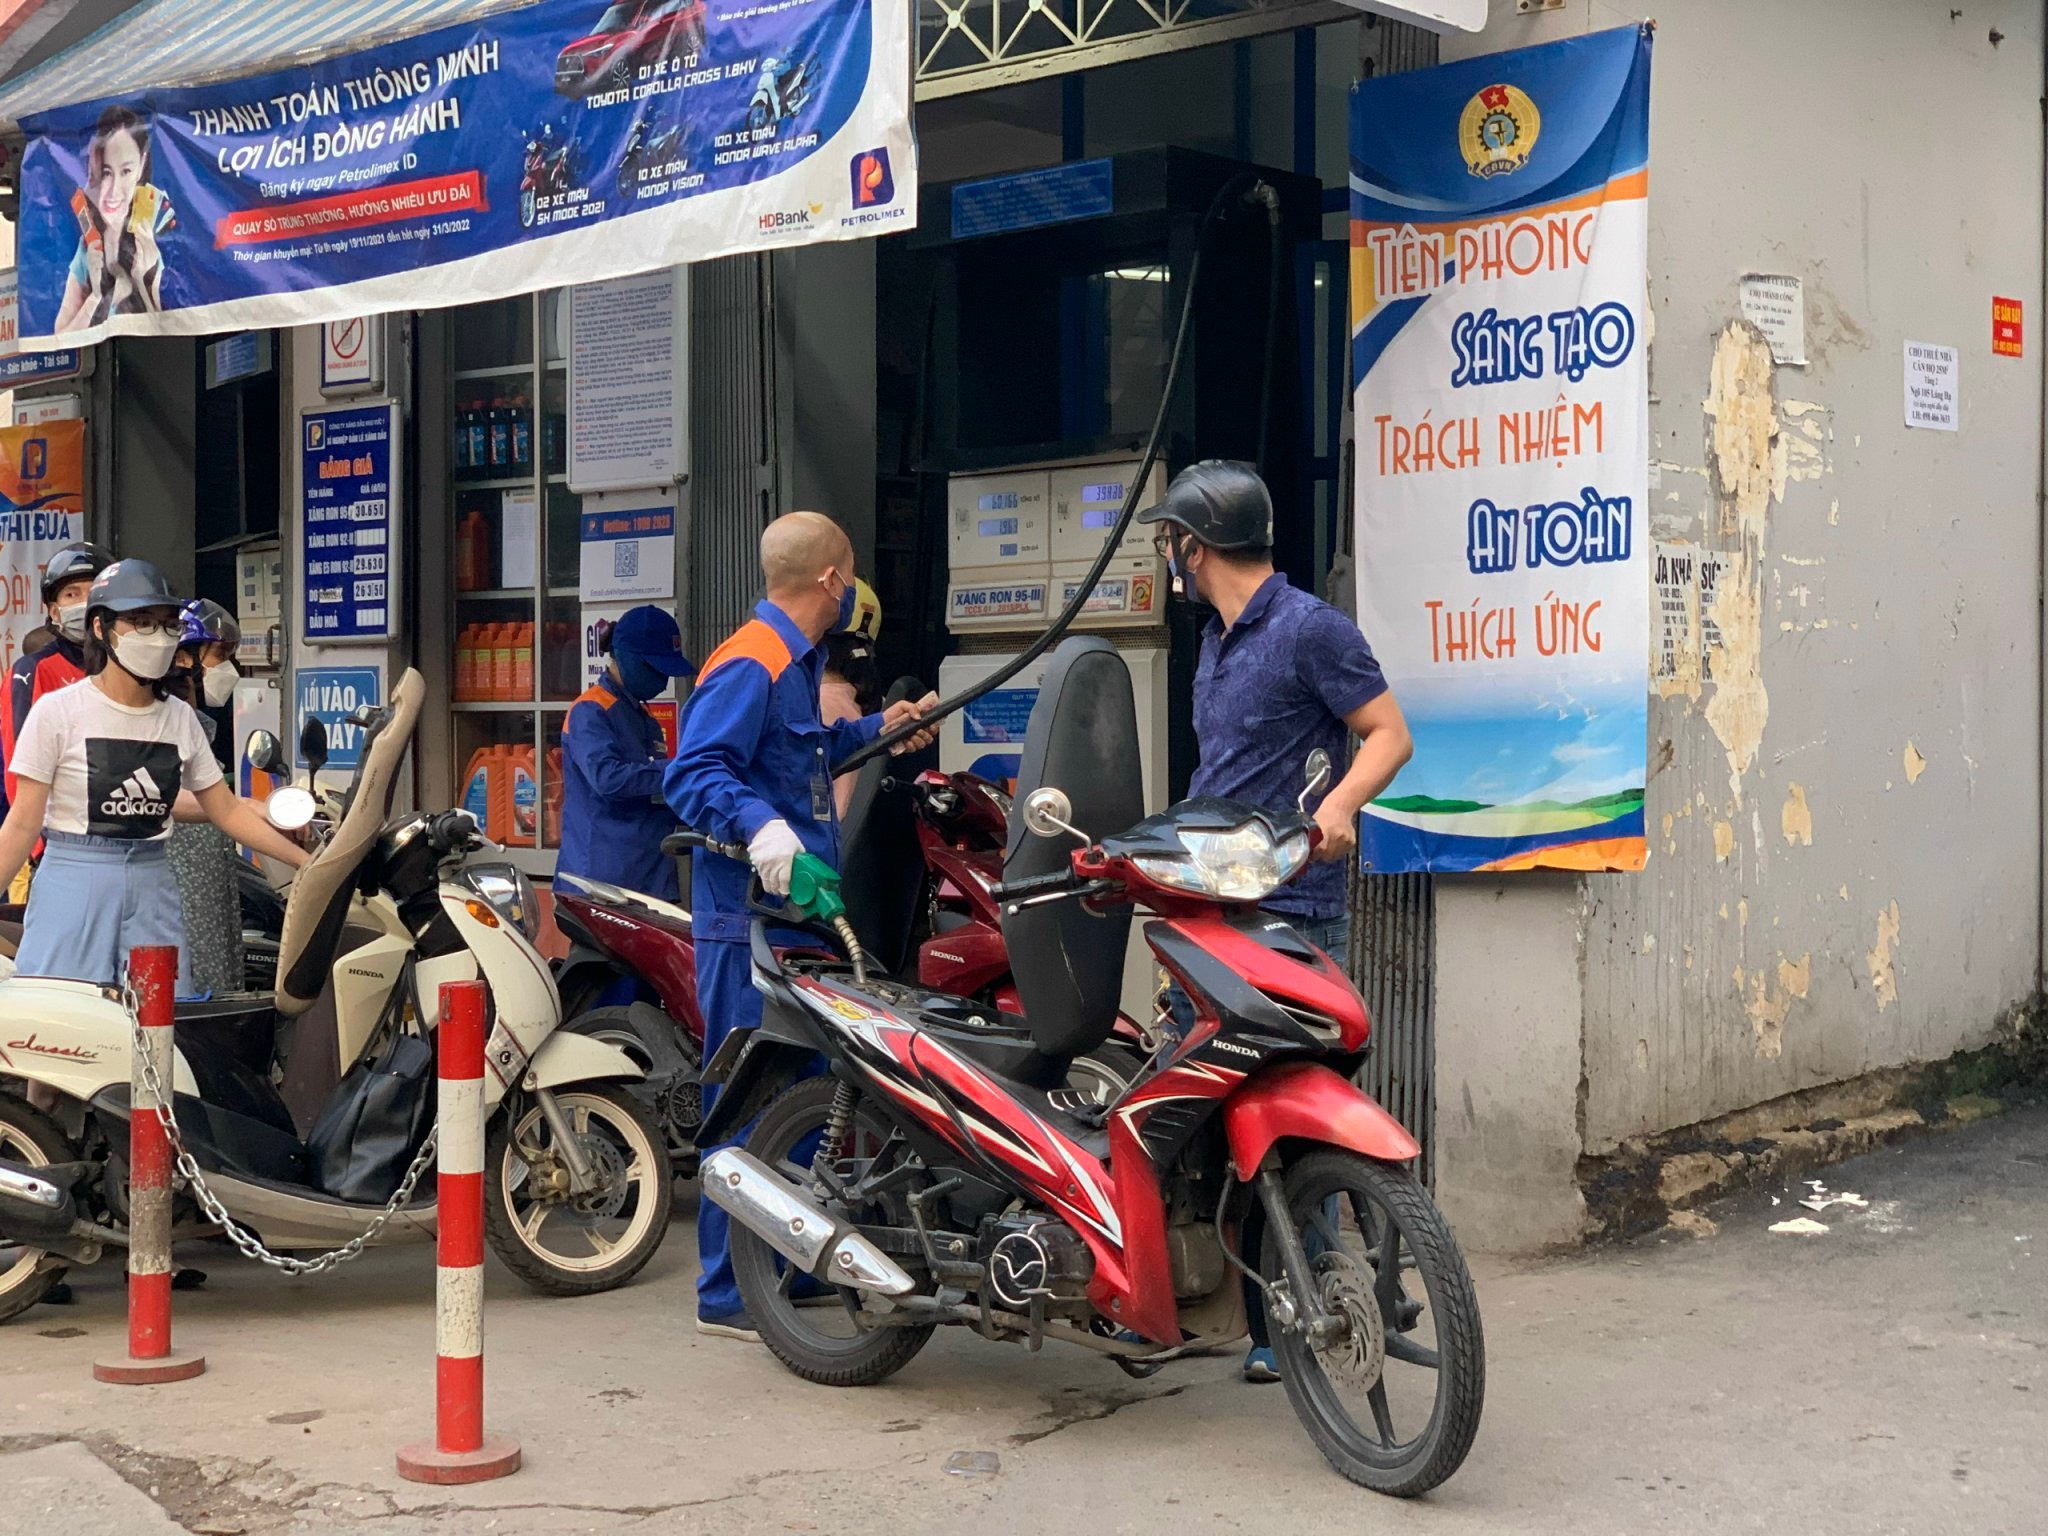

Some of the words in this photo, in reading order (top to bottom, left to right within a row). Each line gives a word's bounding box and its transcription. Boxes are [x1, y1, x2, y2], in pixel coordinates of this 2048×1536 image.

[638, 64, 652, 81] 01
[653, 60, 668, 76] XE
[671, 56, 681, 73] Ô
[189, 102, 272, 136] THANH
[270, 81, 340, 125] TOÁN
[343, 66, 431, 110] THÔNG
[436, 40, 499, 86] MINH
[586, 88, 630, 109] TOYOTA
[632, 77, 683, 100] COROLLA
[683, 67, 722, 87] CROSS
[724, 58, 757, 78] 1.8HV
[217, 145, 265, 178] LỢI
[264, 136, 306, 169] ÍCH
[312, 121, 386, 163] ĐỒNG
[388, 97, 460, 144] HÀNH
[713, 132, 733, 148] 100
[734, 132, 750, 148] XE
[713, 147, 752, 167] HONDA
[751, 142, 782, 159] WAVE
[782, 133, 818, 154] ALPHA
[260, 183, 289, 199] Đăng
[289, 178, 305, 196] ký
[305, 174, 337, 192] ngay
[337, 159, 401, 185] Petrolimex
[402, 152, 418, 171] ID
[636, 181, 670, 200] HONDA
[671, 173, 704, 192] VISION
[637, 168, 649, 182] 10
[649, 165, 663, 180] XE
[231, 220, 262, 236] QUAY
[390, 190, 425, 212] NHIỀU
[427, 188, 448, 206] ƯU
[448, 184, 472, 202] ĐÃI
[536, 196, 549, 210] 02
[552, 193, 566, 205] XE
[536, 211, 551, 226] SH
[552, 205, 580, 221] MODE
[581, 201, 606, 216] 2021
[758, 209, 809, 229] HDBank
[840, 207, 906, 227] PETROLIMEX
[253, 248, 273, 264] gian
[431, 217, 472, 237] 31/3/2022
[1373, 227, 1440, 296] TIÊN
[1459, 215, 1595, 285] PHONG
[1451, 307, 1543, 388] SÁNG
[1547, 301, 1635, 383] TẠO
[1908, 346, 1922, 358] CHO
[1498, 392, 1603, 470] NHIỆM
[319, 454, 351, 479] BẢNG
[352, 451, 374, 476] GIÁ
[33, 511, 71, 541] ĐUA
[325, 507, 340, 520] RON
[325, 534, 339, 547] RON
[1467, 497, 1520, 574] AN
[1524, 486, 1633, 568] TOÀN
[989, 590, 1012, 604] RON
[1015, 588, 1041, 602] 95-III
[1534, 590, 1602, 658] ỨNG
[304, 677, 319, 712] LỐI
[321, 679, 356, 712] VÀO
[101, 797, 168, 816] adidas
[590, 908, 641, 931] VISION
[930, 949, 966, 964] HONDA
[348, 968, 385, 979] HONDA
[1212, 1039, 1261, 1059] HONDA
